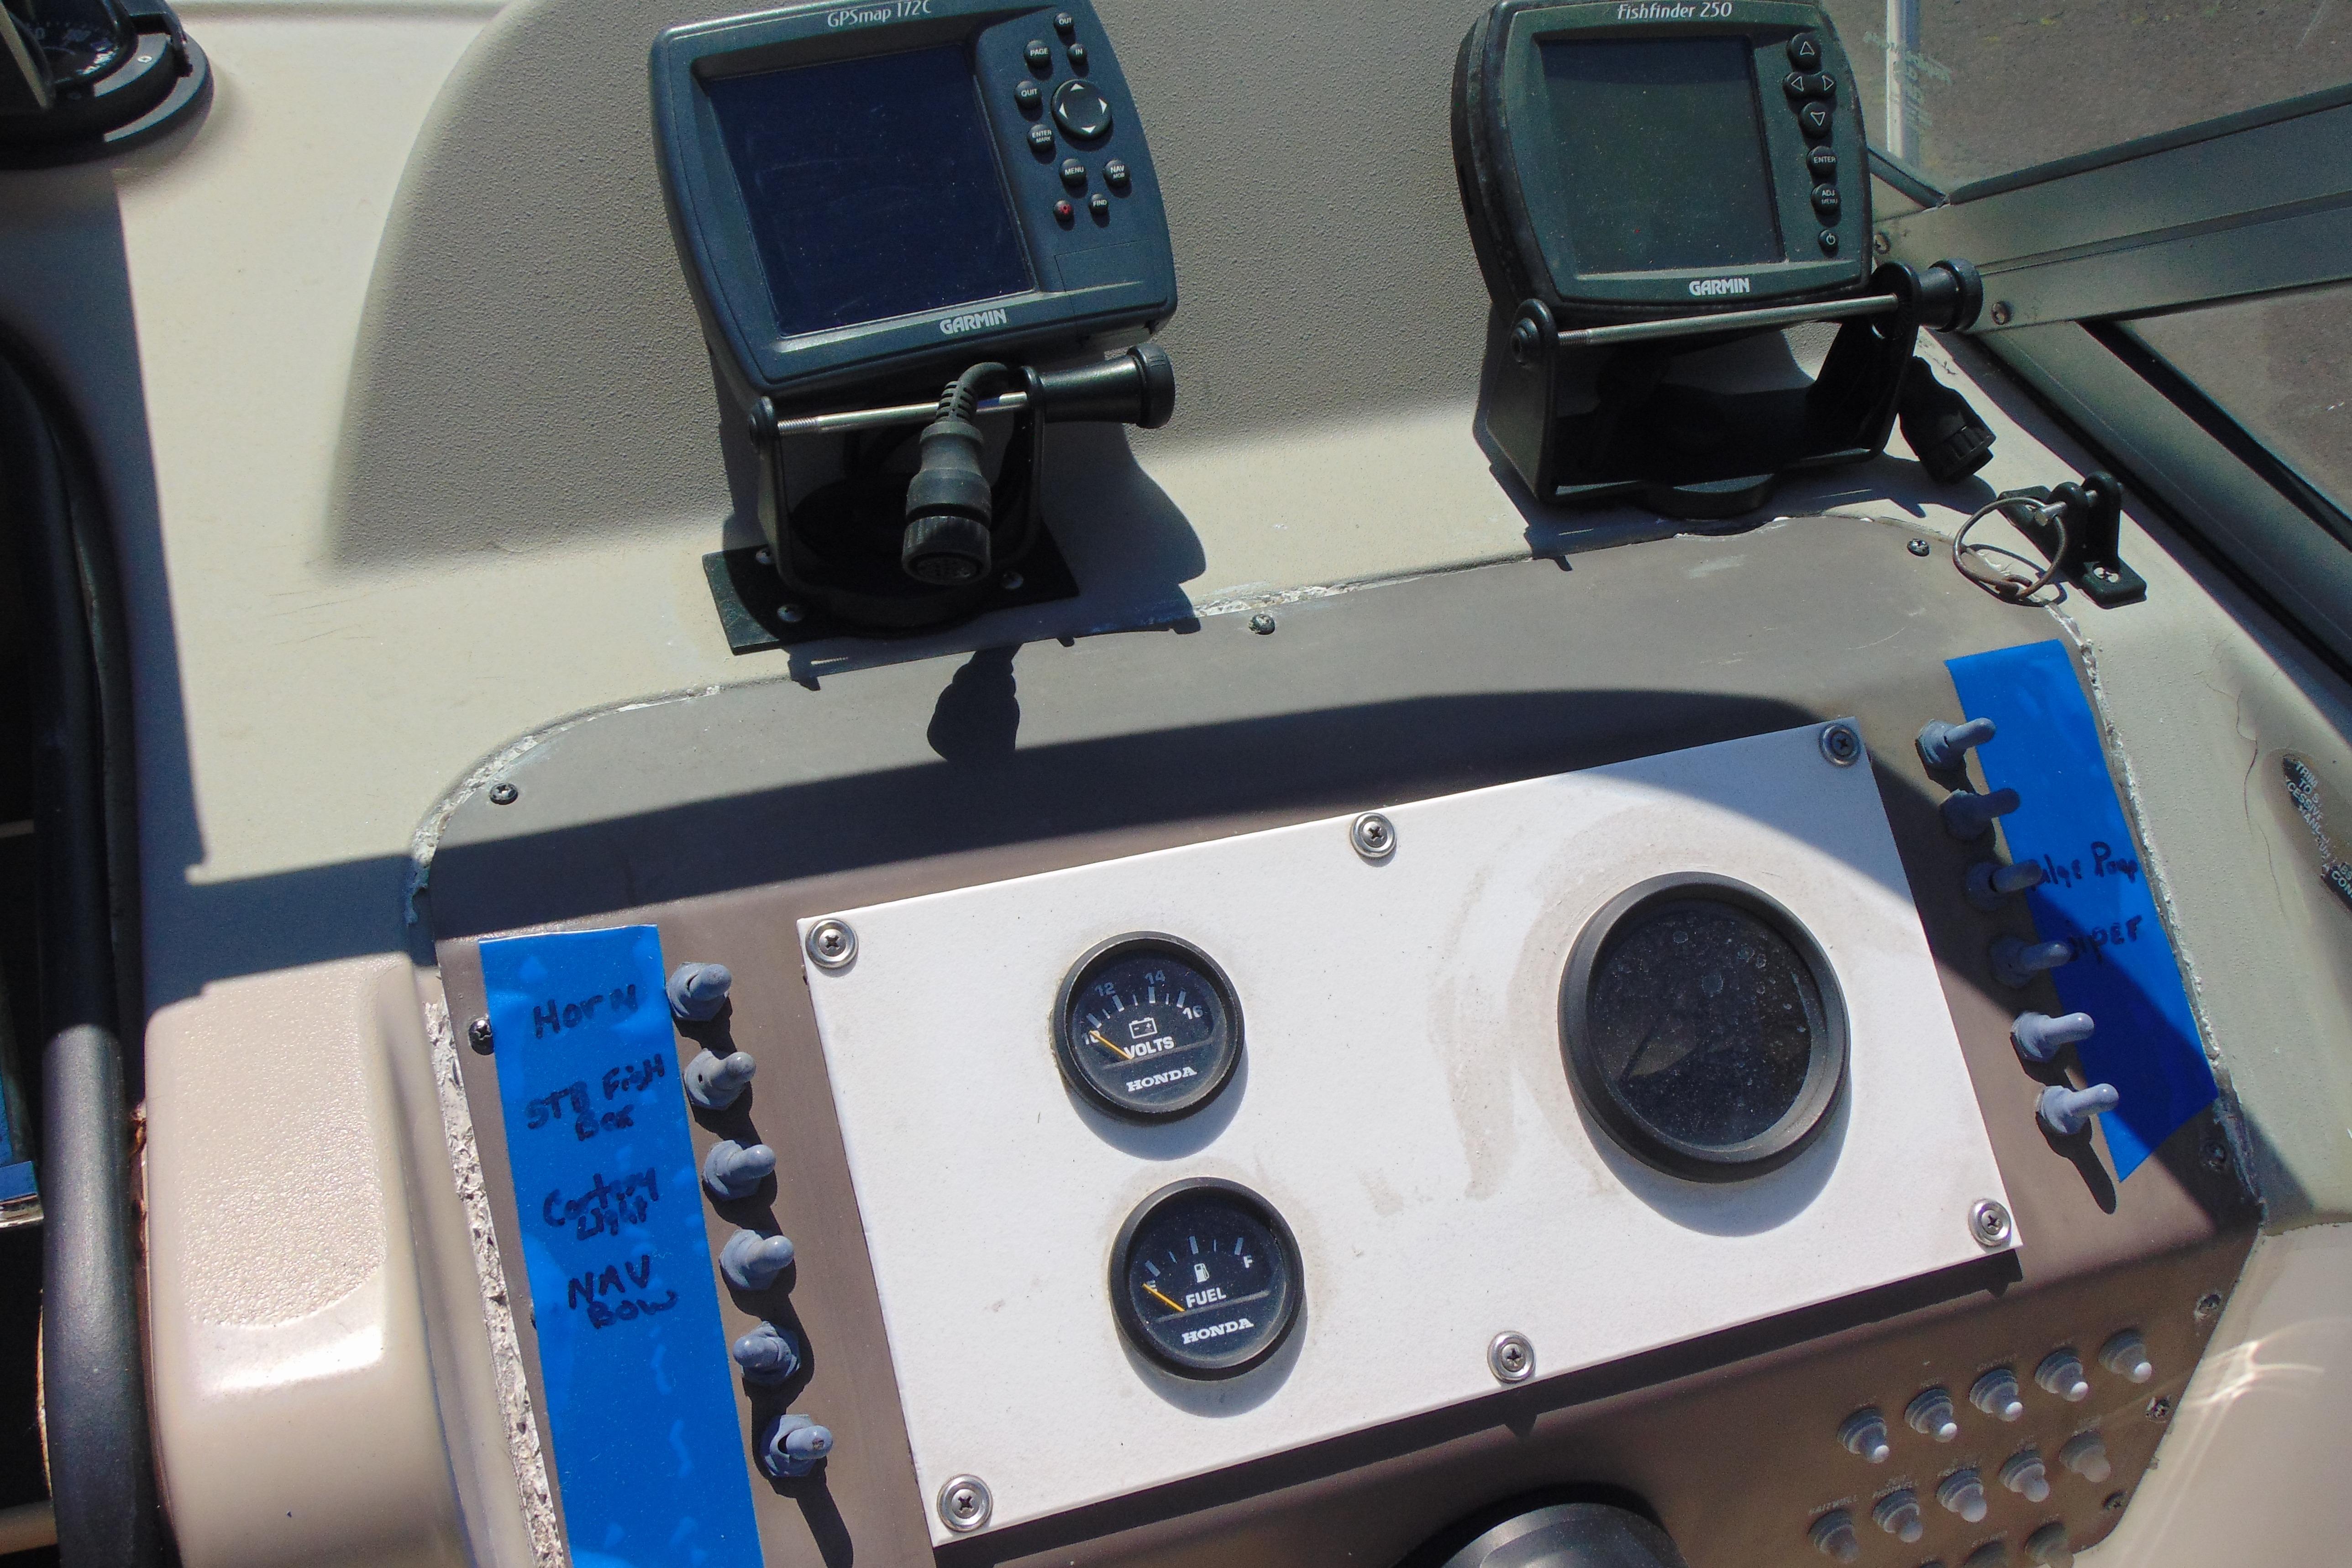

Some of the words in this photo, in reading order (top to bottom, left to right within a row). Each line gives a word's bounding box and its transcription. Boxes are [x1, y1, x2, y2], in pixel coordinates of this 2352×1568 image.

[827, 8, 892, 28] GPSmap
[898, 0, 931, 17] 172C
[1700, 2, 1732, 18] 250
[1030, 48, 1049, 56] PAGE
[1021, 88, 1037, 97] QUIT
[1032, 130, 1052, 138] ENTER
[1813, 156, 1836, 164] ENTER
[1065, 166, 1084, 176] MENU
[1110, 165, 1125, 173] NAV
[1689, 277, 1750, 296] GARMIN
[940, 309, 1007, 335] GARMIN
[2296, 761, 2318, 788] TRIM
[2299, 777, 2312, 795] TO
[1145, 970, 1166, 985] 14
[1095, 982, 1115, 996] 12
[1182, 1005, 1203, 1019] 16
[1082, 1030, 1101, 1045] 10
[1124, 1036, 1175, 1059] VOLTS
[1126, 1066, 1197, 1092] HONDA
[1243, 1254, 1253, 1269] F
[567, 1254, 651, 1310] NAV
[1186, 1287, 1227, 1308] FUEL
[1181, 1318, 1255, 1344] HONDA
